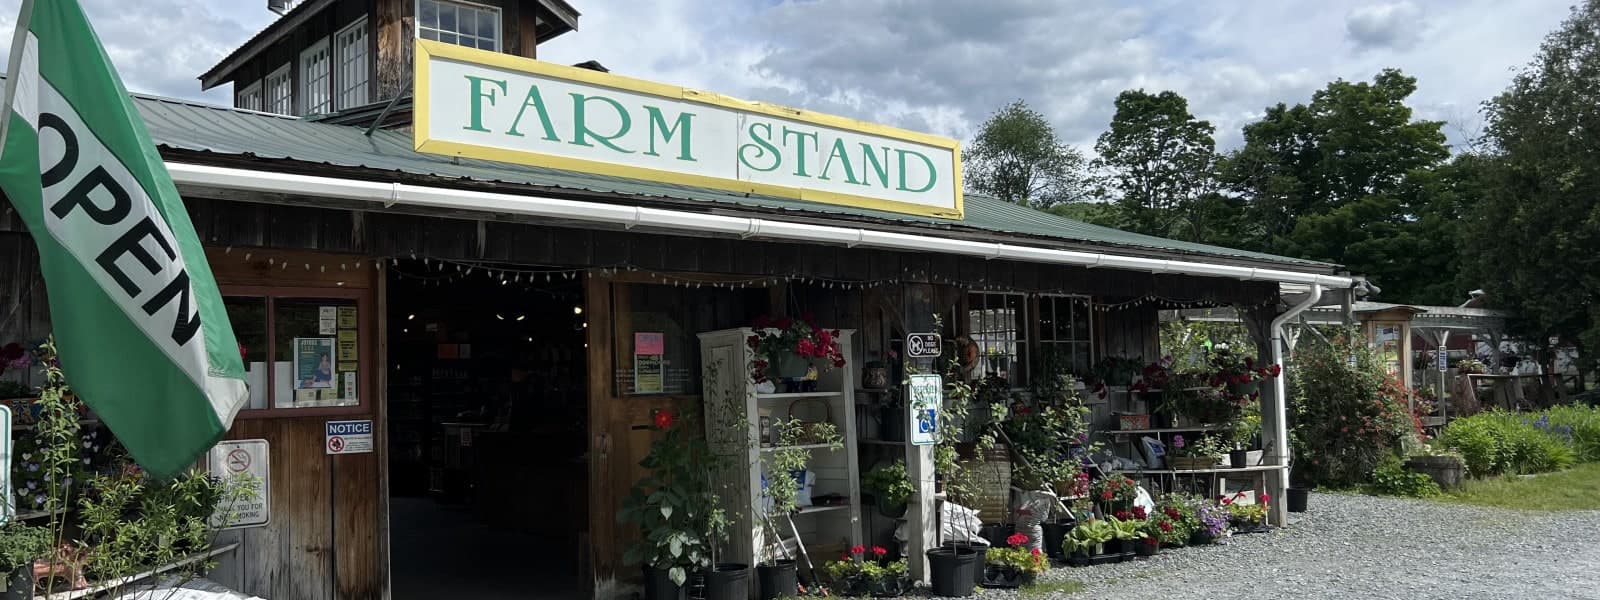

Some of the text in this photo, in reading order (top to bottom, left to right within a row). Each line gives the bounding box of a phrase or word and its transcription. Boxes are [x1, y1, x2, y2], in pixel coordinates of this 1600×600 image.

[463, 75, 937, 193] FARM STAND
[38, 112, 201, 347] OPEN
[328, 423, 370, 434] NOTICE
[235, 511, 260, 519] MOKING
